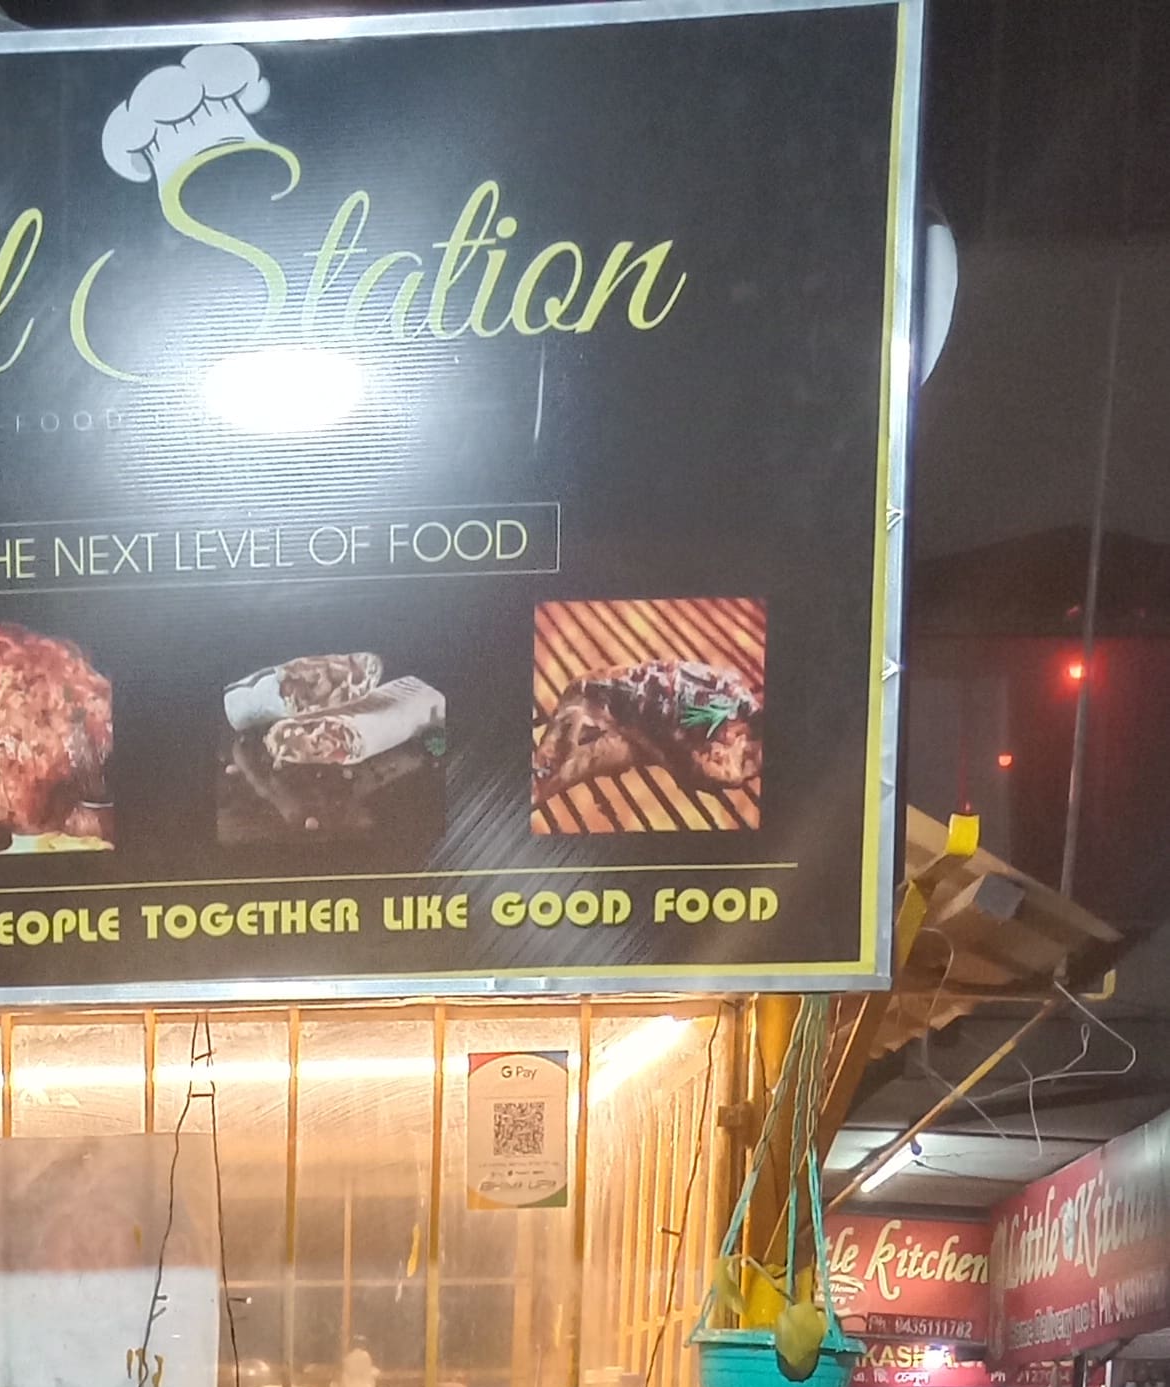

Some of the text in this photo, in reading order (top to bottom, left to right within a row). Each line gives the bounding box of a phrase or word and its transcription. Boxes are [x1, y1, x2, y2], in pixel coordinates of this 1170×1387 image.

[70, 139, 687, 384] Station
[54, 532, 159, 577] NEXT
[175, 526, 294, 571] LEVEL
[308, 525, 371, 567] OF
[389, 518, 529, 563] FOOD
[141, 897, 360, 940] TOGETHER
[382, 893, 469, 932] LIKE
[490, 889, 632, 928] GOOD
[654, 887, 779, 923] FOOD
[515, 1065, 537, 1080] Pay
